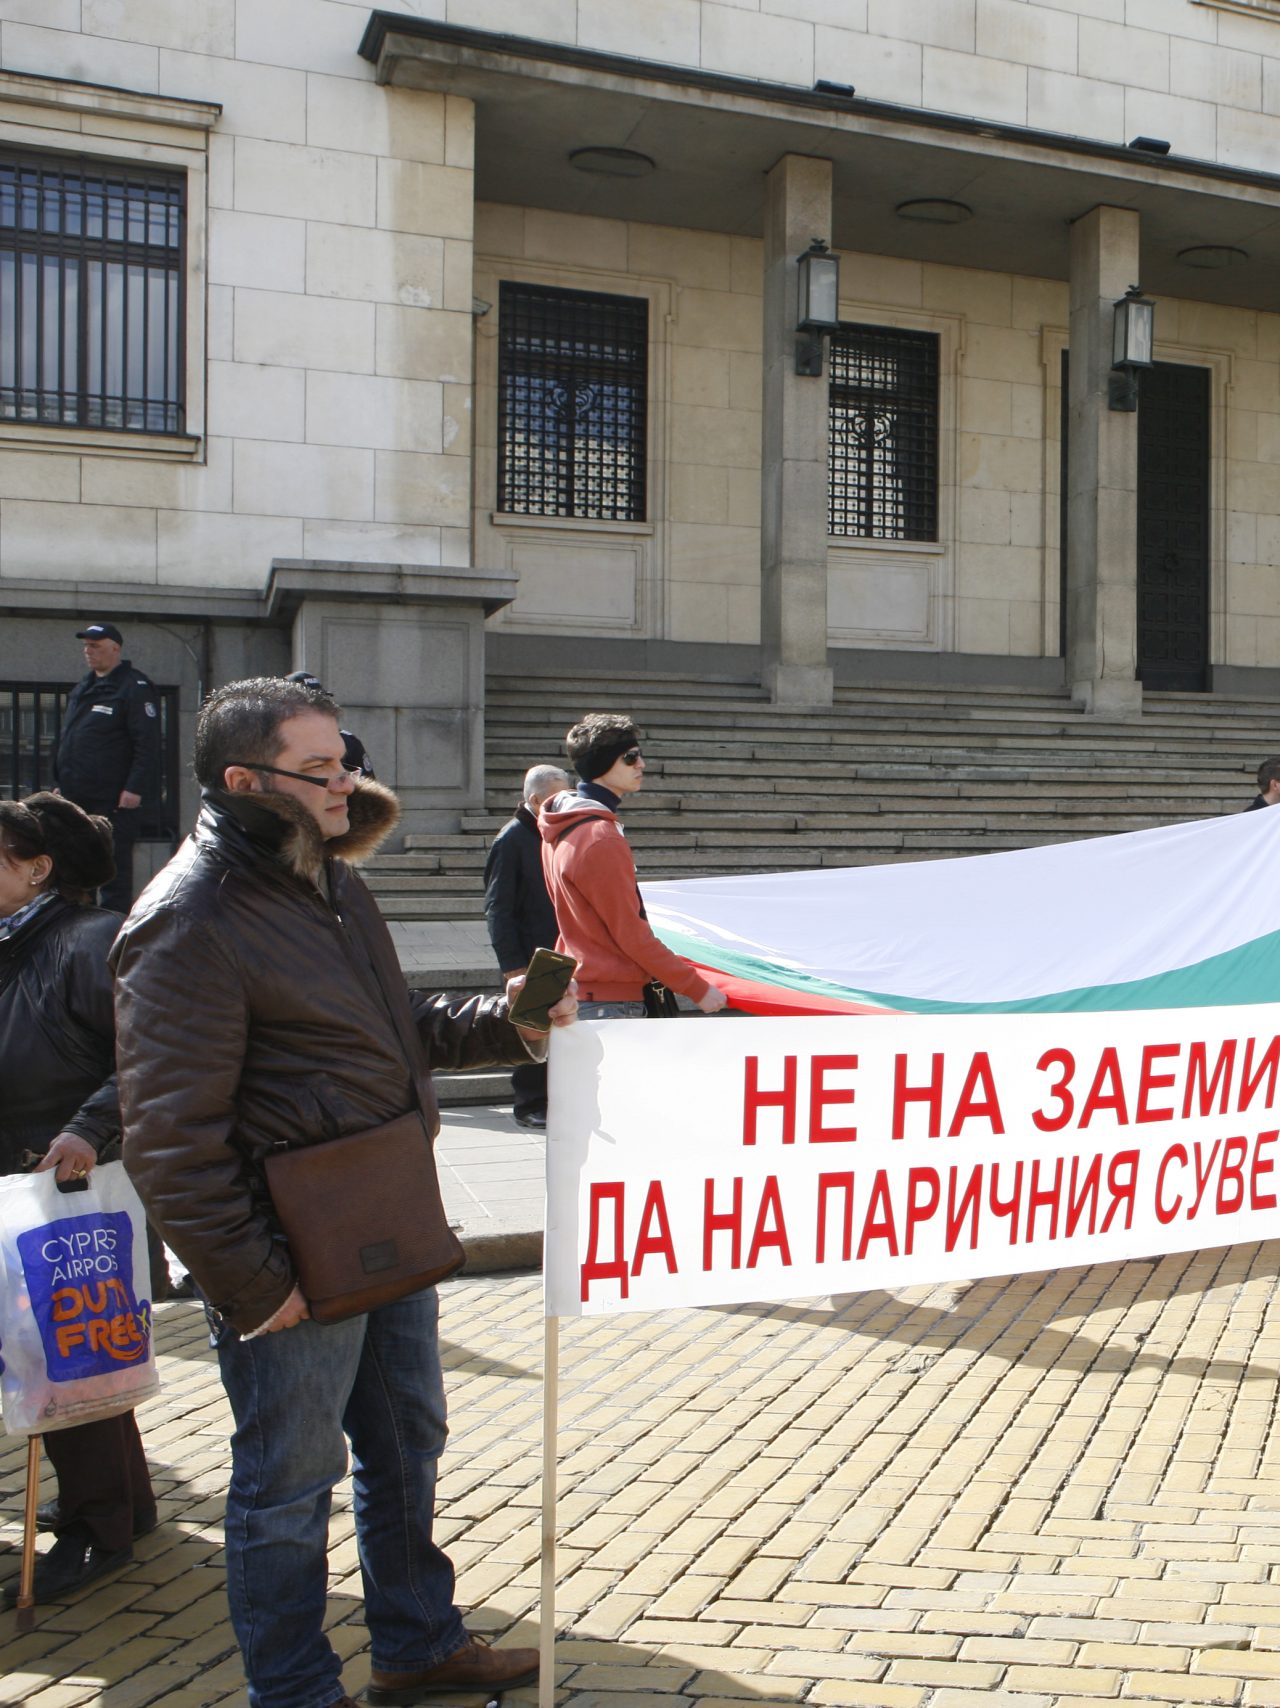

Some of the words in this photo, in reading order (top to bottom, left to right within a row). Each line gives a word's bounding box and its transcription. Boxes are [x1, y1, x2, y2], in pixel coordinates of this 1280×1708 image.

[743, 1054, 859, 1146] НЕ
[891, 1051, 1006, 1141] НА
[42, 1228, 118, 1263] CYPRS
[580, 1179, 679, 1303] ДА
[702, 1175, 793, 1272] НА
[815, 1148, 1141, 1264] ПАРИЧНИЯ
